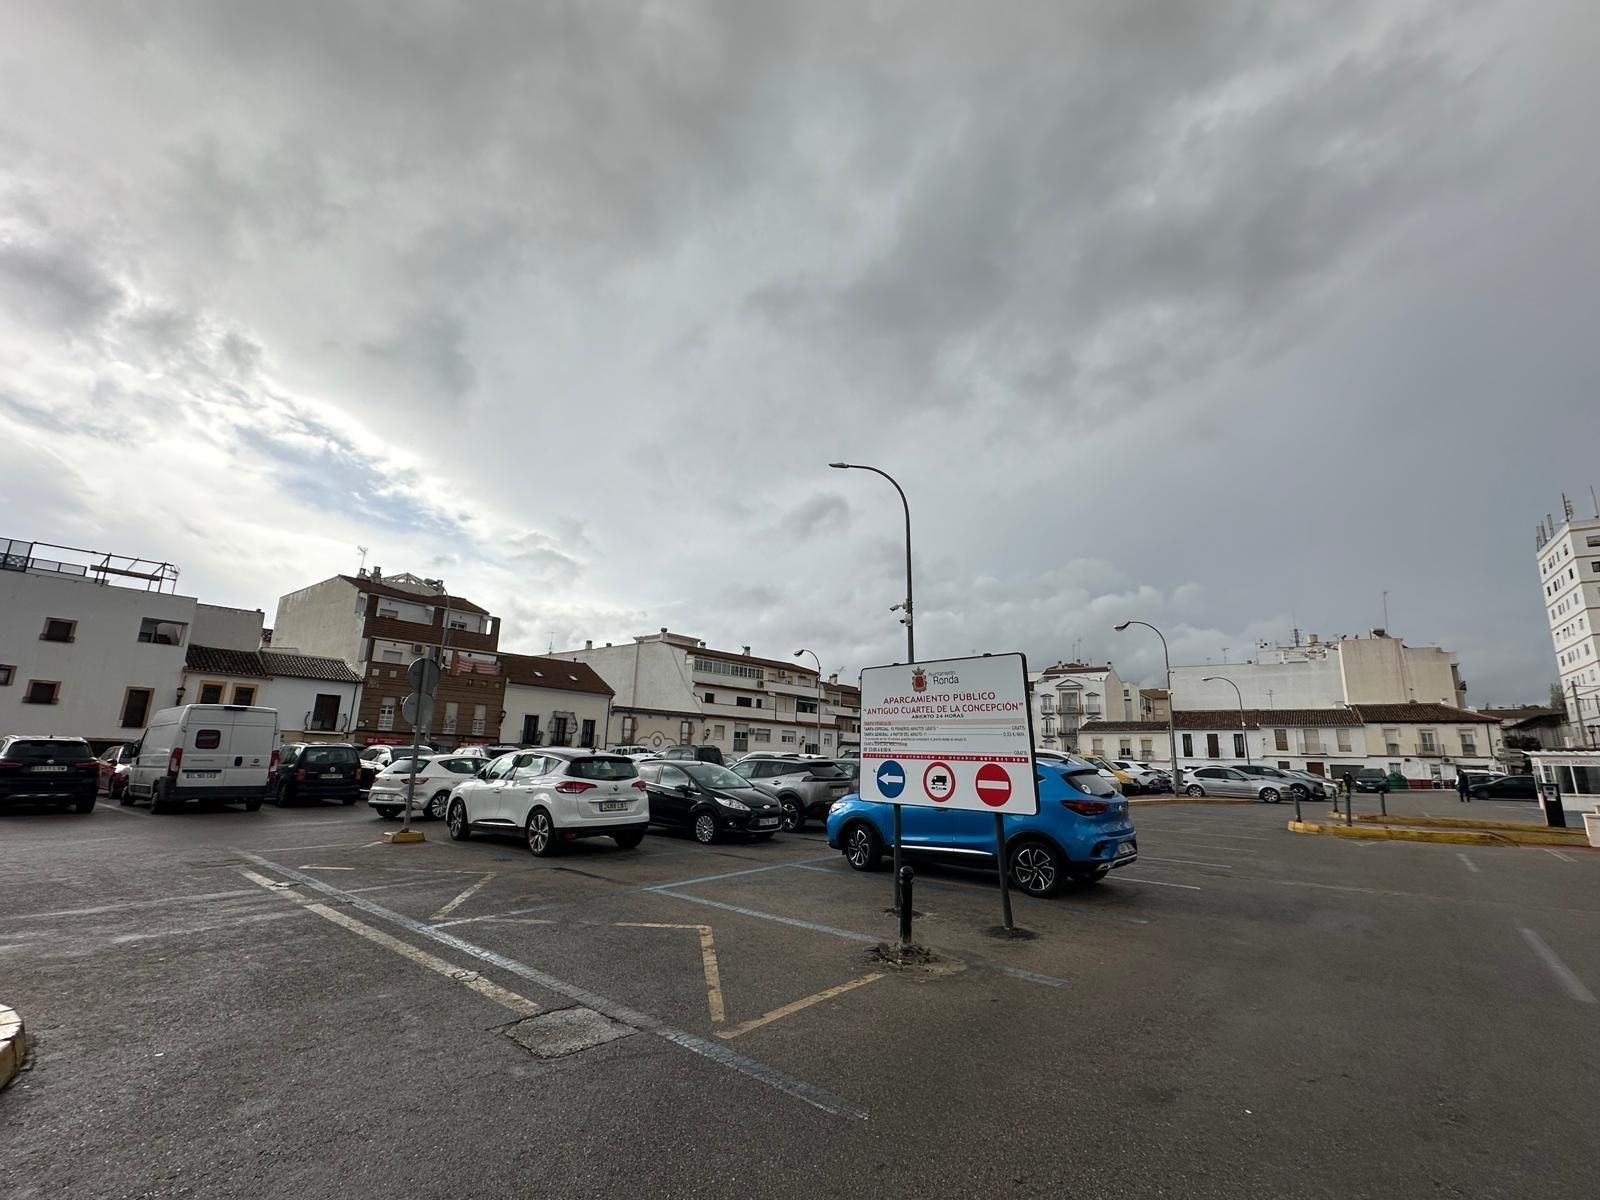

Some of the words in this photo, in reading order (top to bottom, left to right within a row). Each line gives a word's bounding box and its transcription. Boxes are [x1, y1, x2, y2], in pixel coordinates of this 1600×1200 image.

[933, 675, 960, 685] Ronda
[883, 694, 950, 705] APARCAMIENTO
[900, 705, 934, 714] CUARTEL
[936, 705, 948, 713] DE
[950, 704, 961, 712] LA
